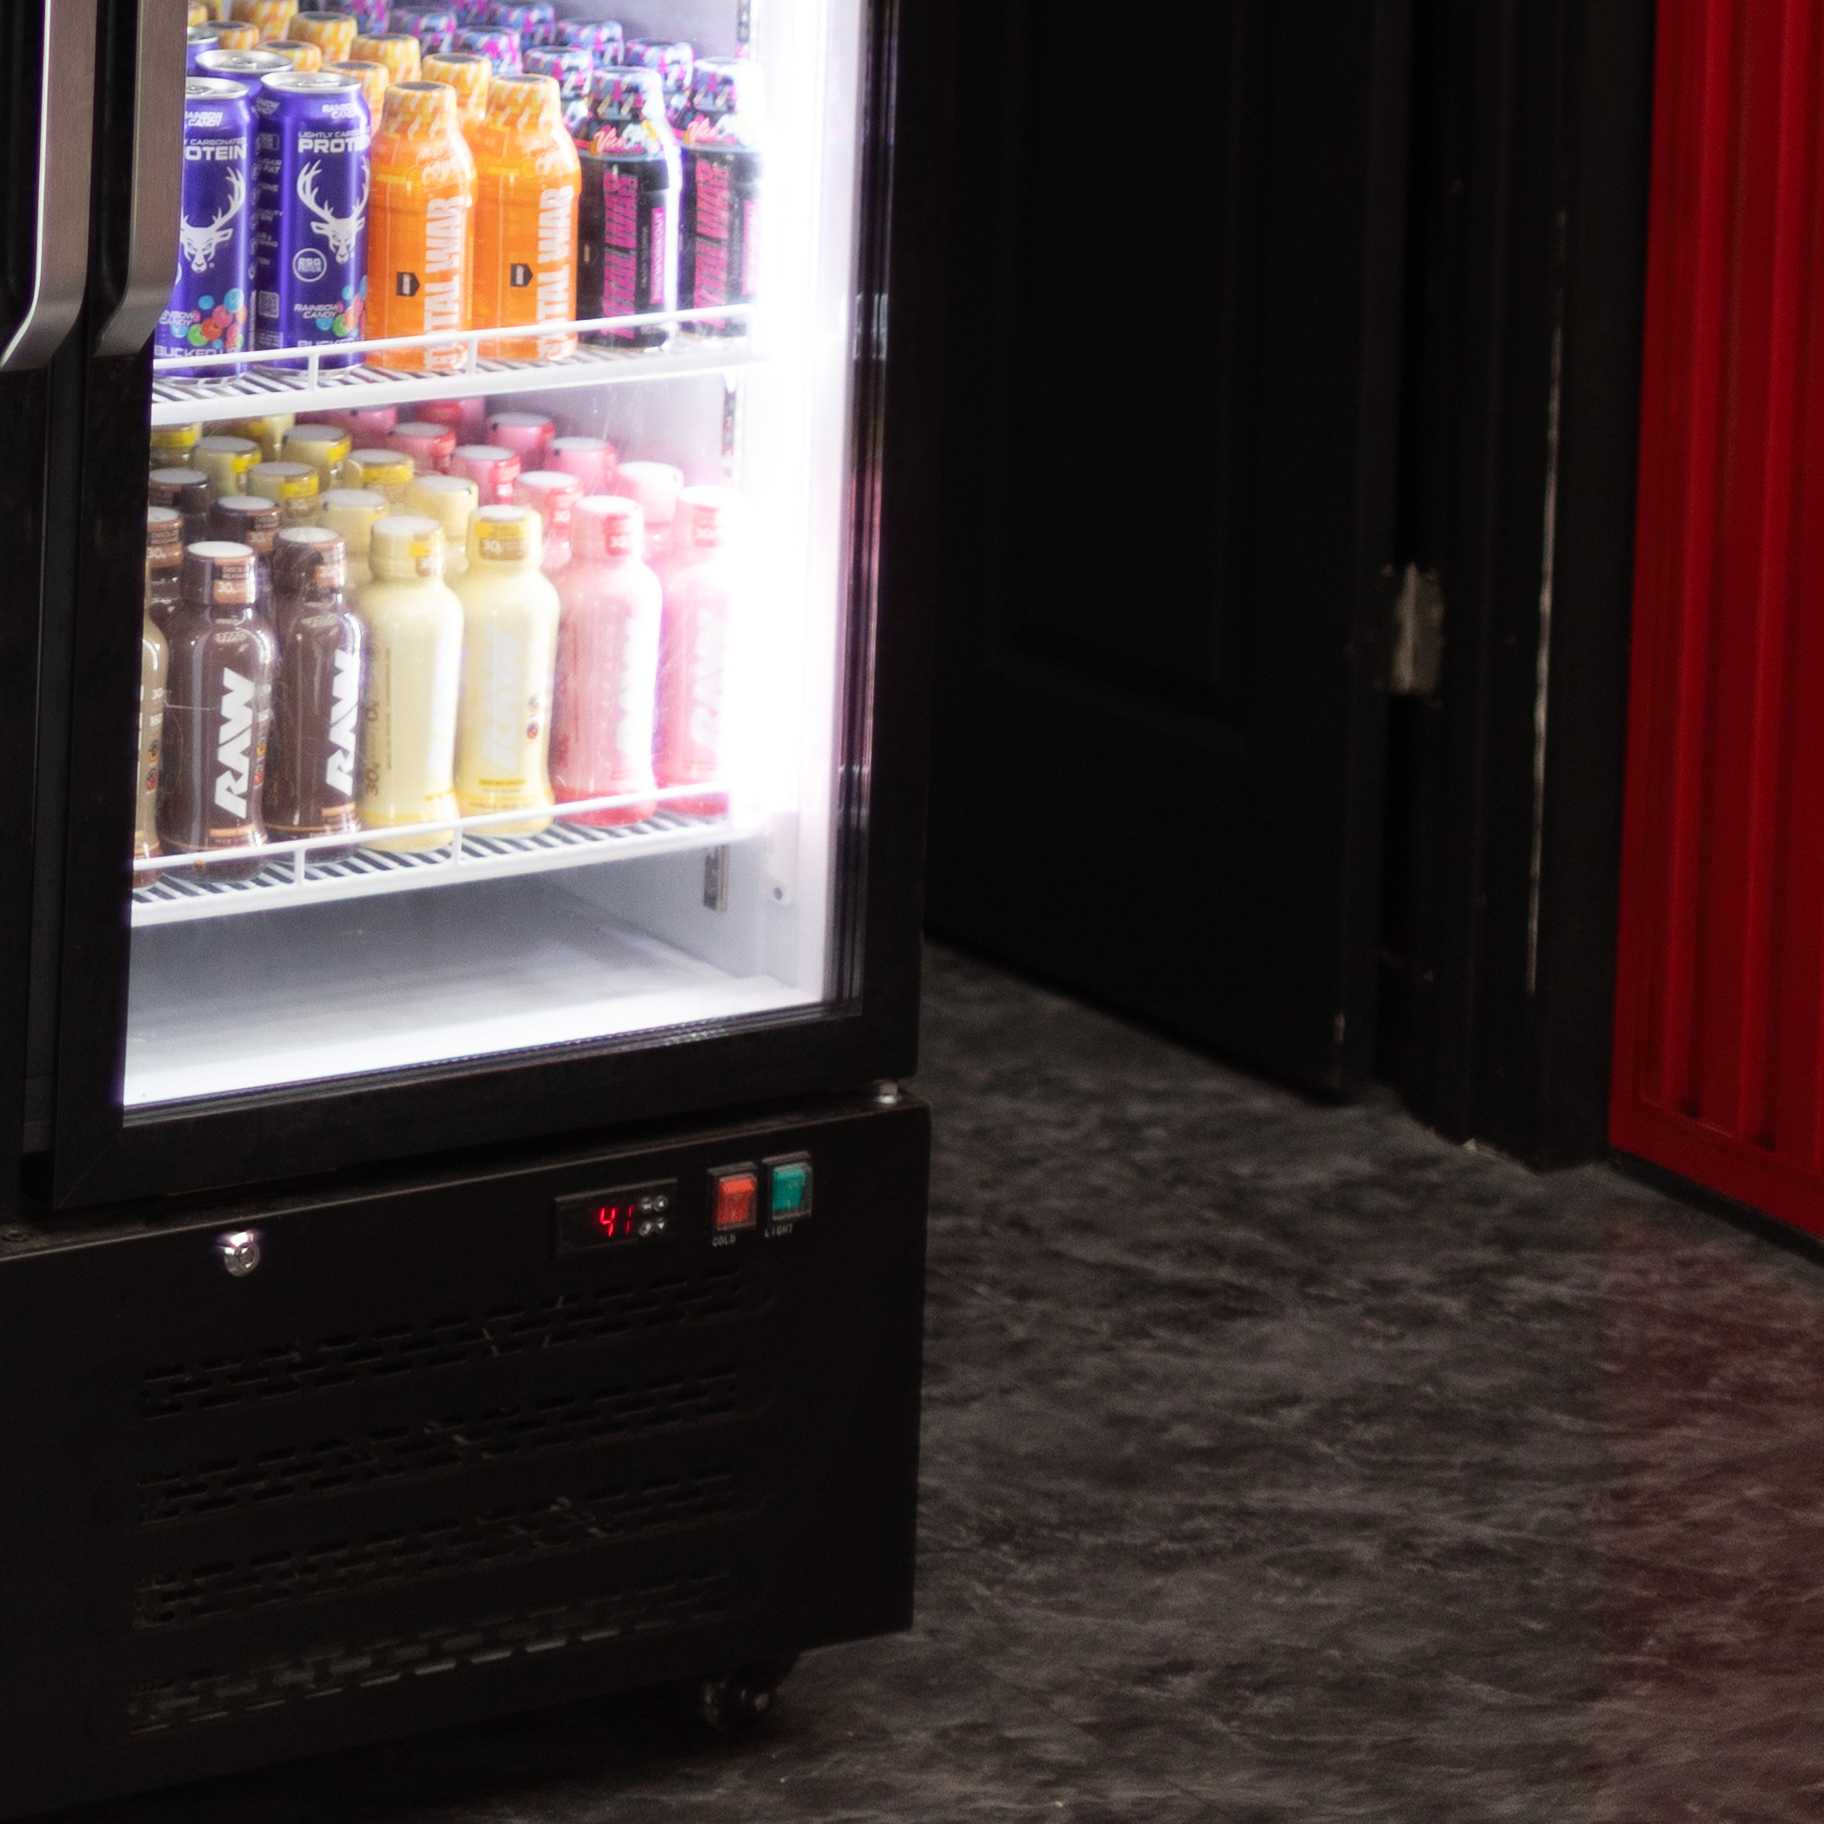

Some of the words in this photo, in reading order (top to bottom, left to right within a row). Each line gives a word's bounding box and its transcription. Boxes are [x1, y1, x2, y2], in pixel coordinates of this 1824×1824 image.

[185, 143, 248, 161] OTEIN
[297, 131, 336, 140] LIGHTLY
[425, 196, 467, 274] WAR
[538, 185, 573, 264] WAR
[302, 310, 336, 320] CANDY
[214, 667, 255, 819] RAW
[326, 648, 361, 797] RAW
[712, 1235, 737, 1248] COLD
[764, 1222, 793, 1238] LIGHT
